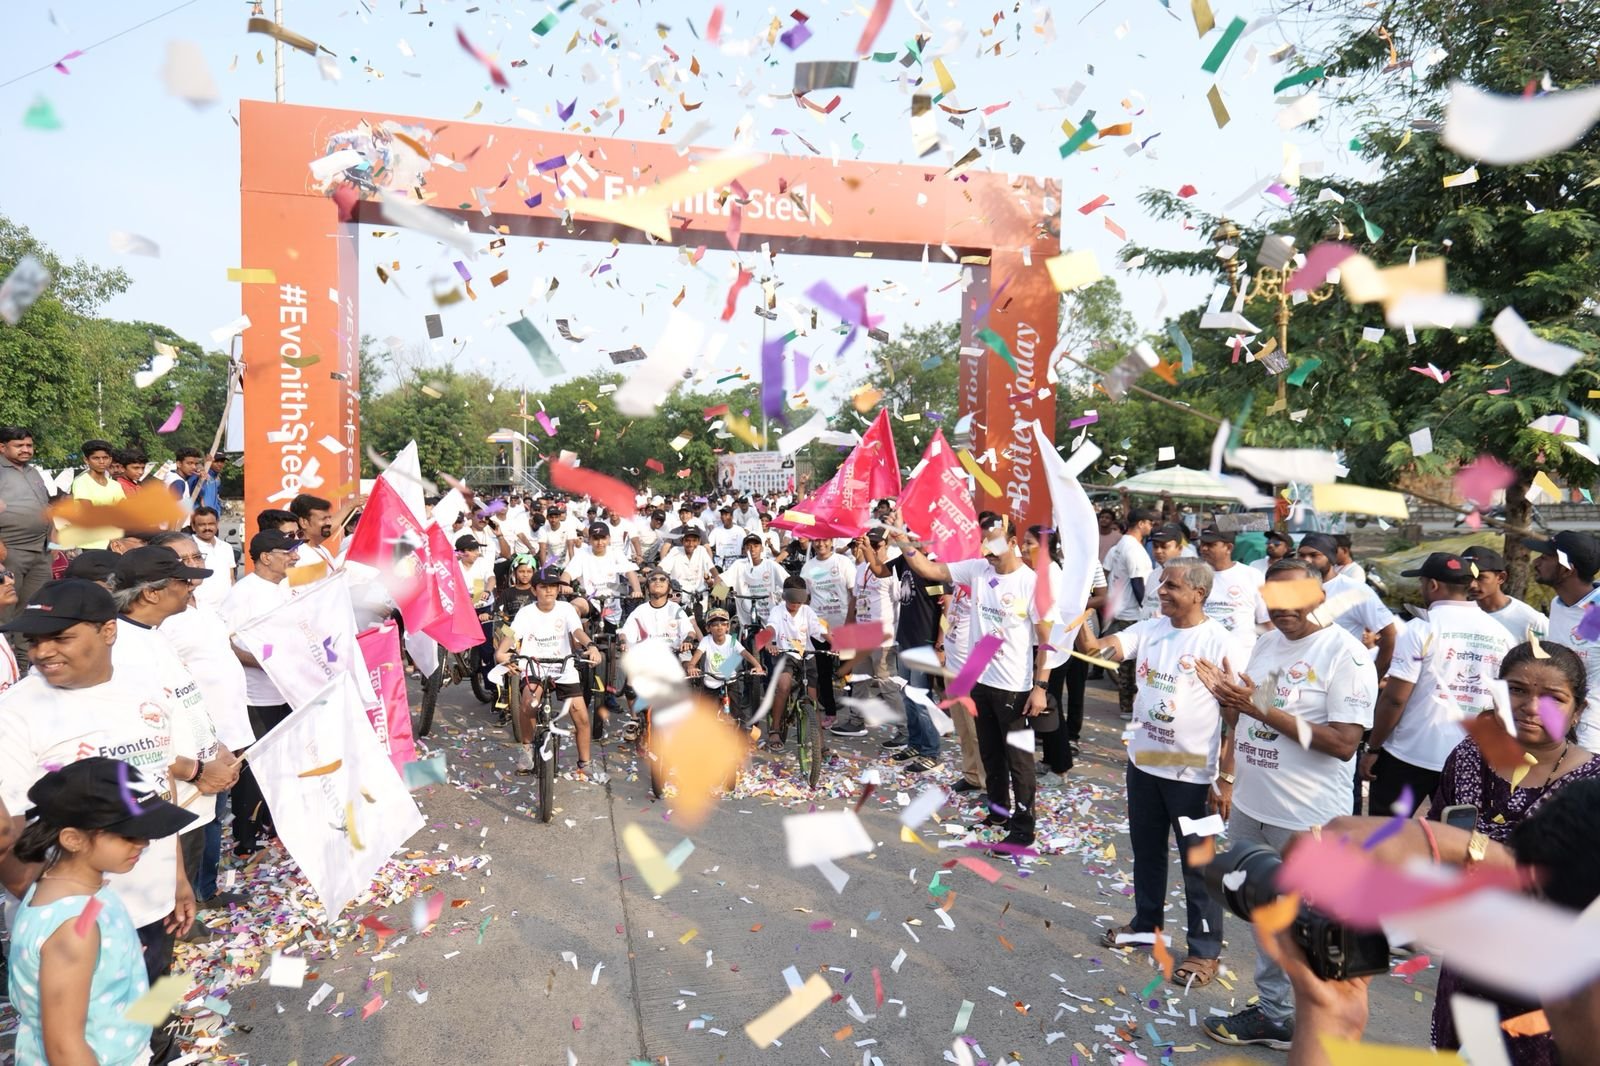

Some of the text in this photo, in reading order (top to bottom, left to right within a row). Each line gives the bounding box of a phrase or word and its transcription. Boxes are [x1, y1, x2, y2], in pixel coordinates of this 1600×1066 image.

[279, 283, 309, 505] #EvonithStee
[1006, 412, 1032, 523] #Bette
[1239, 742, 1280, 761] सचिन पावडे
[1257, 758, 1280, 770] परिवार
